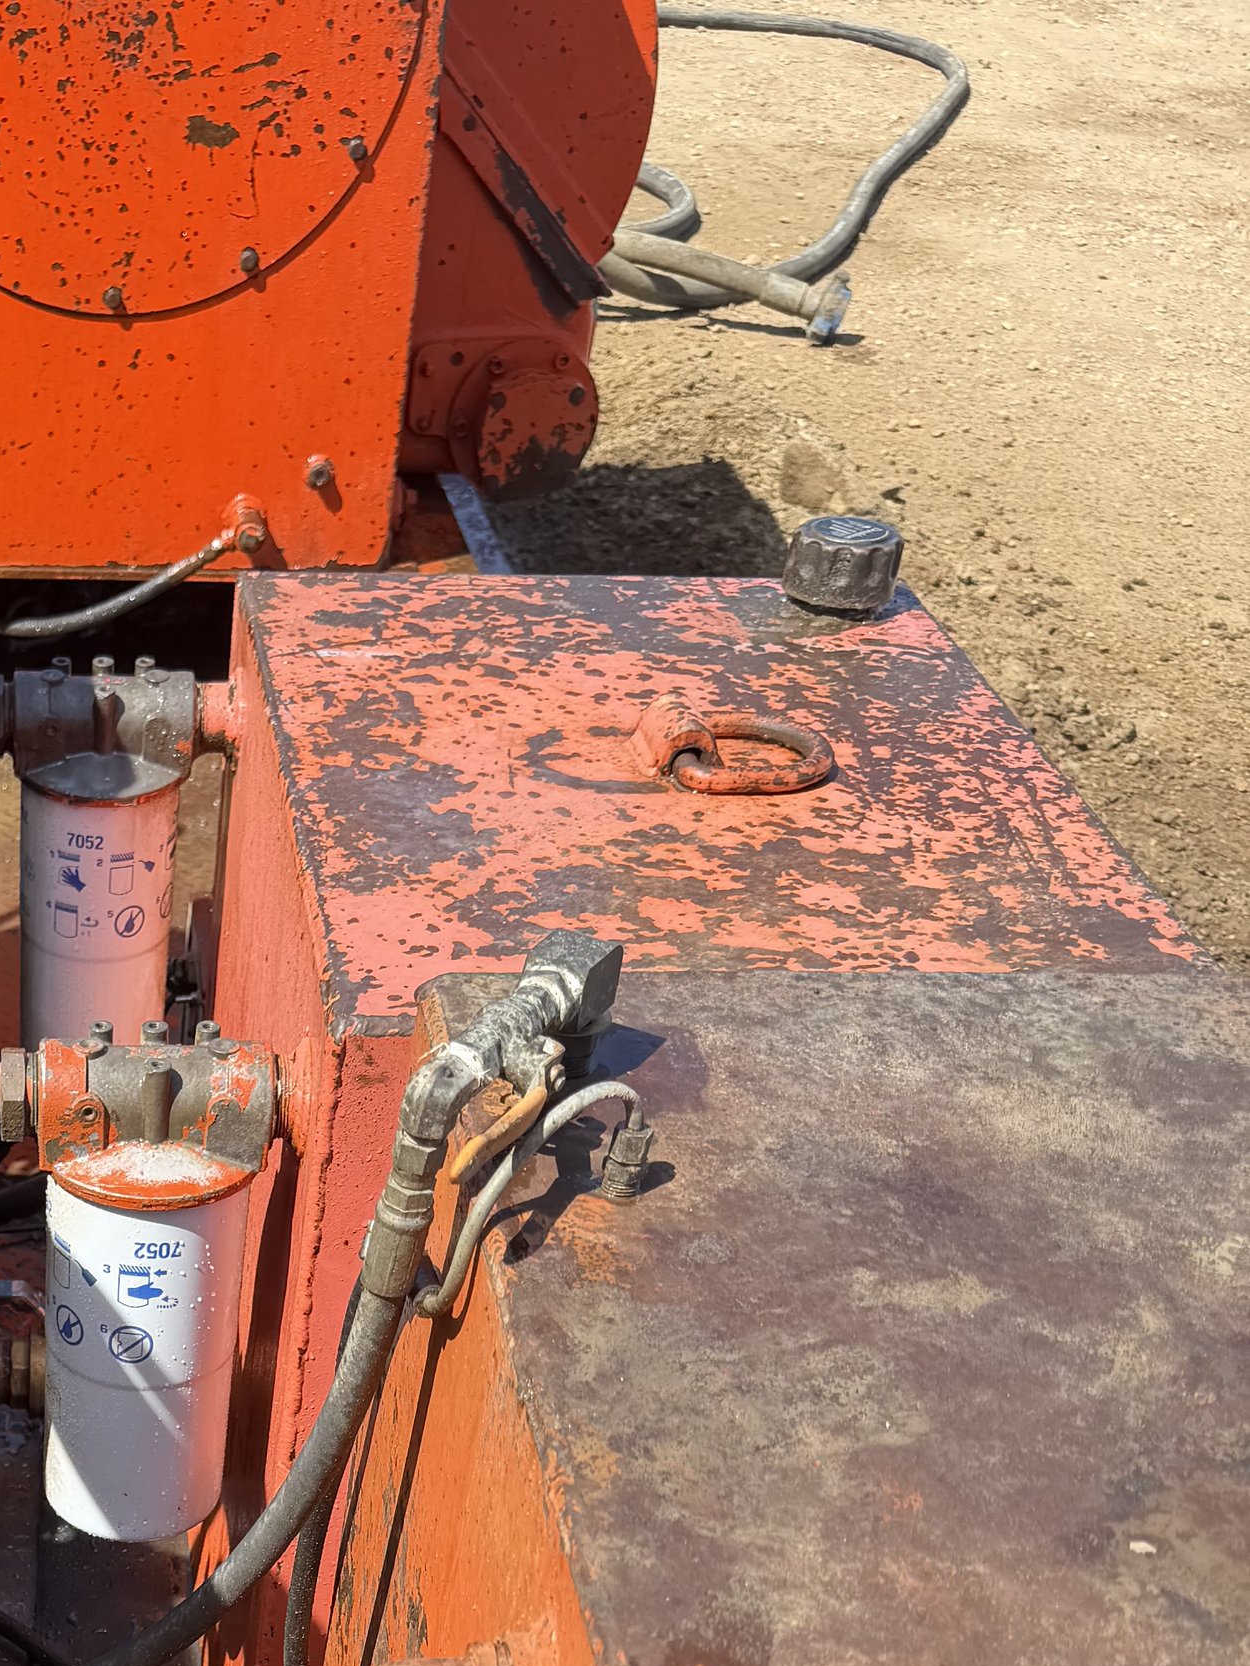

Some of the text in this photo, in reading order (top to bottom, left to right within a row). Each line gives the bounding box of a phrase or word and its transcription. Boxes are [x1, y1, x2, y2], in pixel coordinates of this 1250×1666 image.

[66, 832, 104, 850] 7052
[96, 858, 103, 867] 2
[107, 910, 114, 918] 5
[133, 1241, 184, 1259] 7052
[102, 1264, 111, 1274] 3
[100, 1323, 108, 1334] 6
